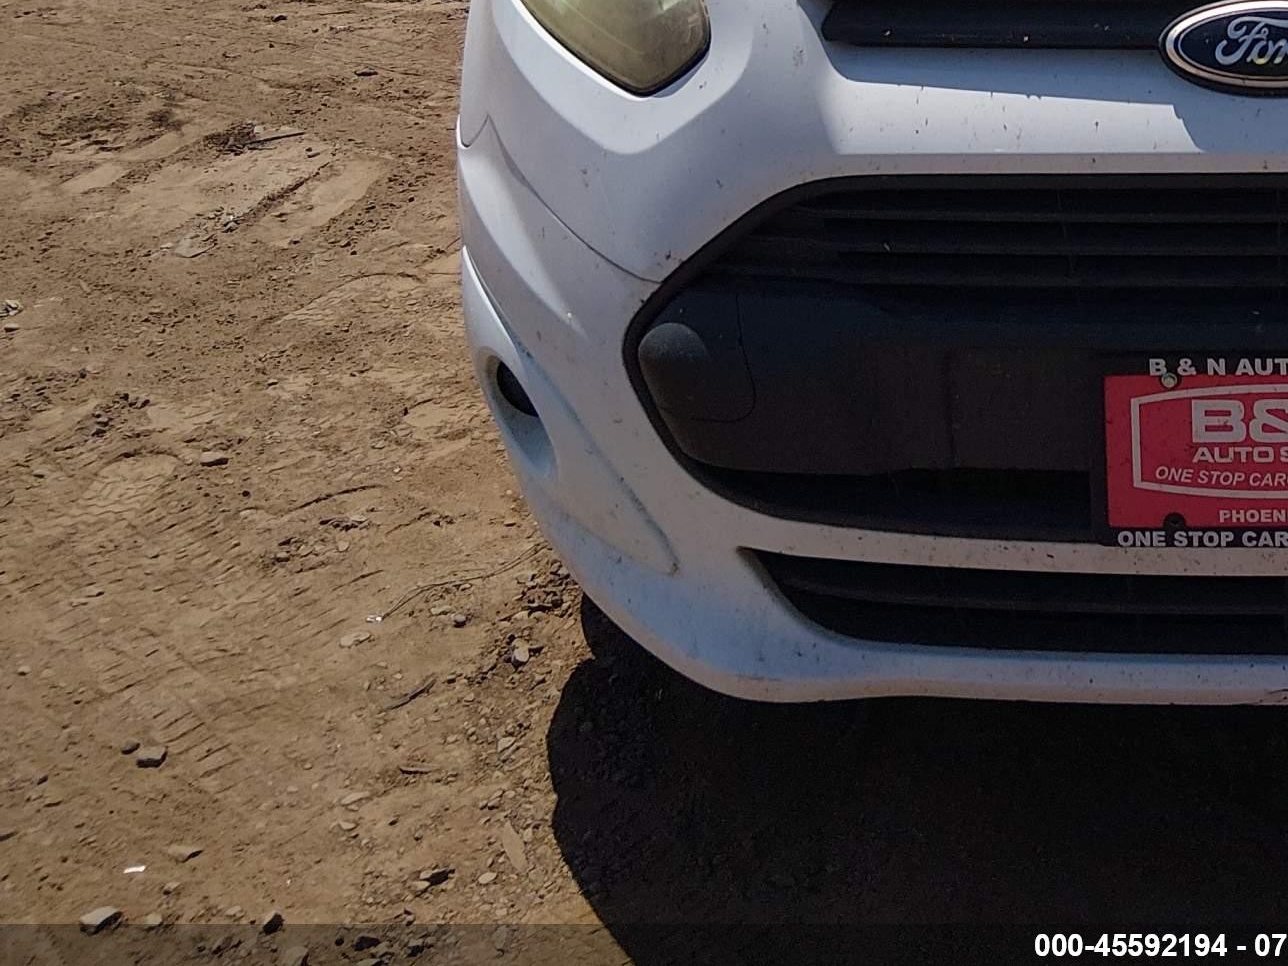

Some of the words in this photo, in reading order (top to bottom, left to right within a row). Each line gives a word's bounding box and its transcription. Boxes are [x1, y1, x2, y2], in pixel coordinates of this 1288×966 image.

[1149, 358, 1168, 375] B
[1177, 358, 1197, 375] &
[1207, 358, 1226, 375] N
[1192, 446, 1275, 463] AUTO
[1155, 465, 1194, 483] ONE
[1199, 470, 1245, 486] STOP
[1117, 530, 1165, 547] ONE
[1174, 531, 1233, 547] STOP
